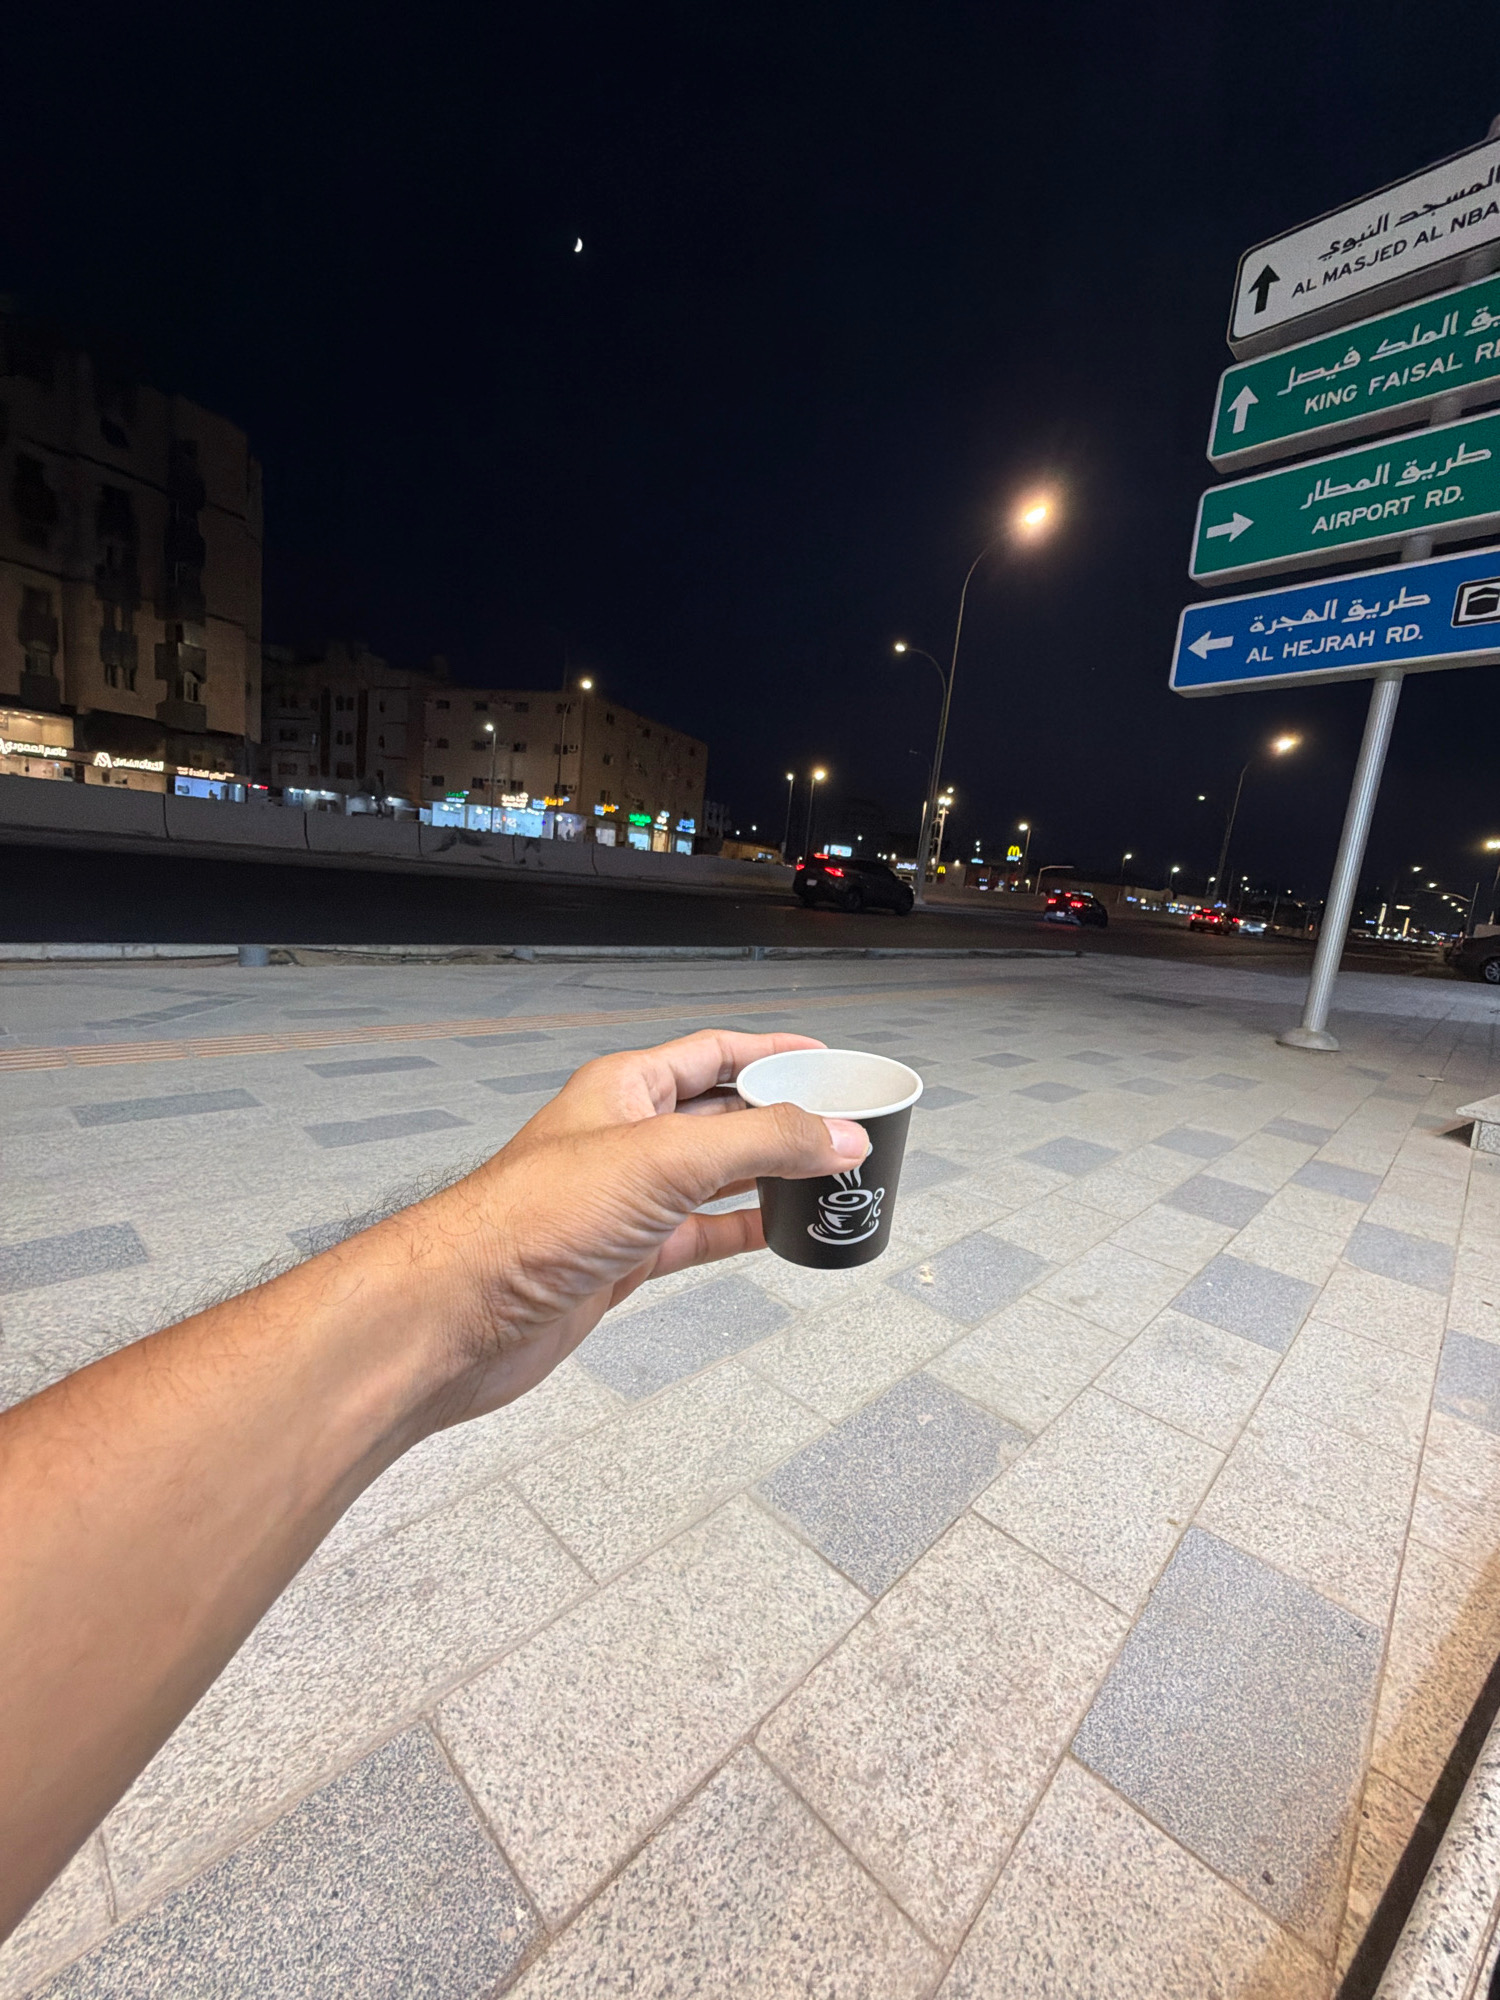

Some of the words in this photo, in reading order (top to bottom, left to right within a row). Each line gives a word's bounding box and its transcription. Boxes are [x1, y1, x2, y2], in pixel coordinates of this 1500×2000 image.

[1394, 165, 1500, 228] المسجد
[1291, 278, 1317, 298] AL
[1322, 239, 1407, 286] MASJED
[1413, 225, 1444, 249] AL
[1317, 211, 1390, 262] النبوي
[1369, 310, 1459, 362] الملك
[1277, 345, 1361, 397] فيصل
[1304, 383, 1357, 415] KING
[1368, 351, 1463, 396] FAISAL
[1300, 462, 1391, 510] المطار
[1394, 443, 1492, 488] طريق
[1311, 494, 1416, 535] AIRPORT
[1424, 485, 1465, 510] RD.
[1249, 598, 1338, 636] الهجرة
[1341, 587, 1431, 624] طريق
[1245, 645, 1274, 664] AL
[1282, 633, 1375, 659] HEJRAH
[1385, 624, 1424, 646] RD.
